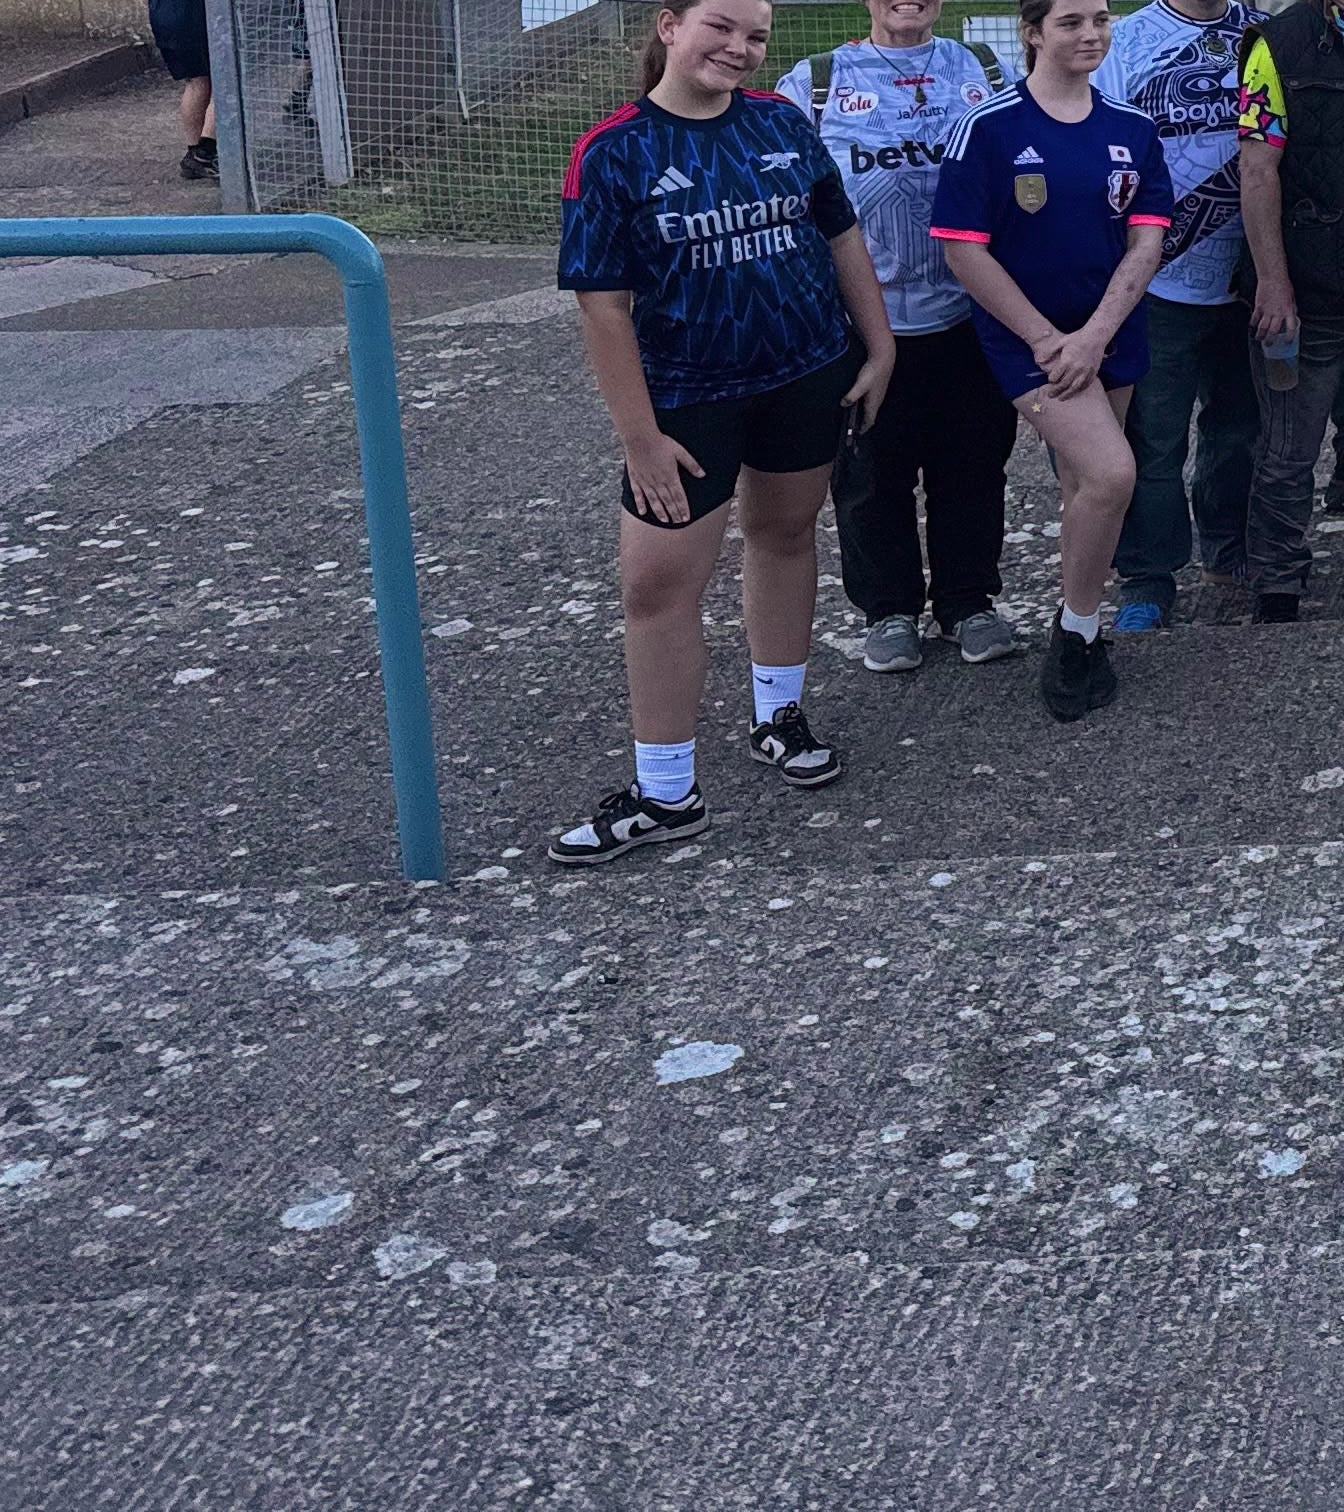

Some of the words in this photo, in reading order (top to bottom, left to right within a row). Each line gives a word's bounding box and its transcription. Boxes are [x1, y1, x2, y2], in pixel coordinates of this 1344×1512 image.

[839, 94, 873, 115] Cola
[655, 191, 811, 245] Emirates
[691, 239, 724, 270] FLY
[731, 224, 798, 264] BETTER
